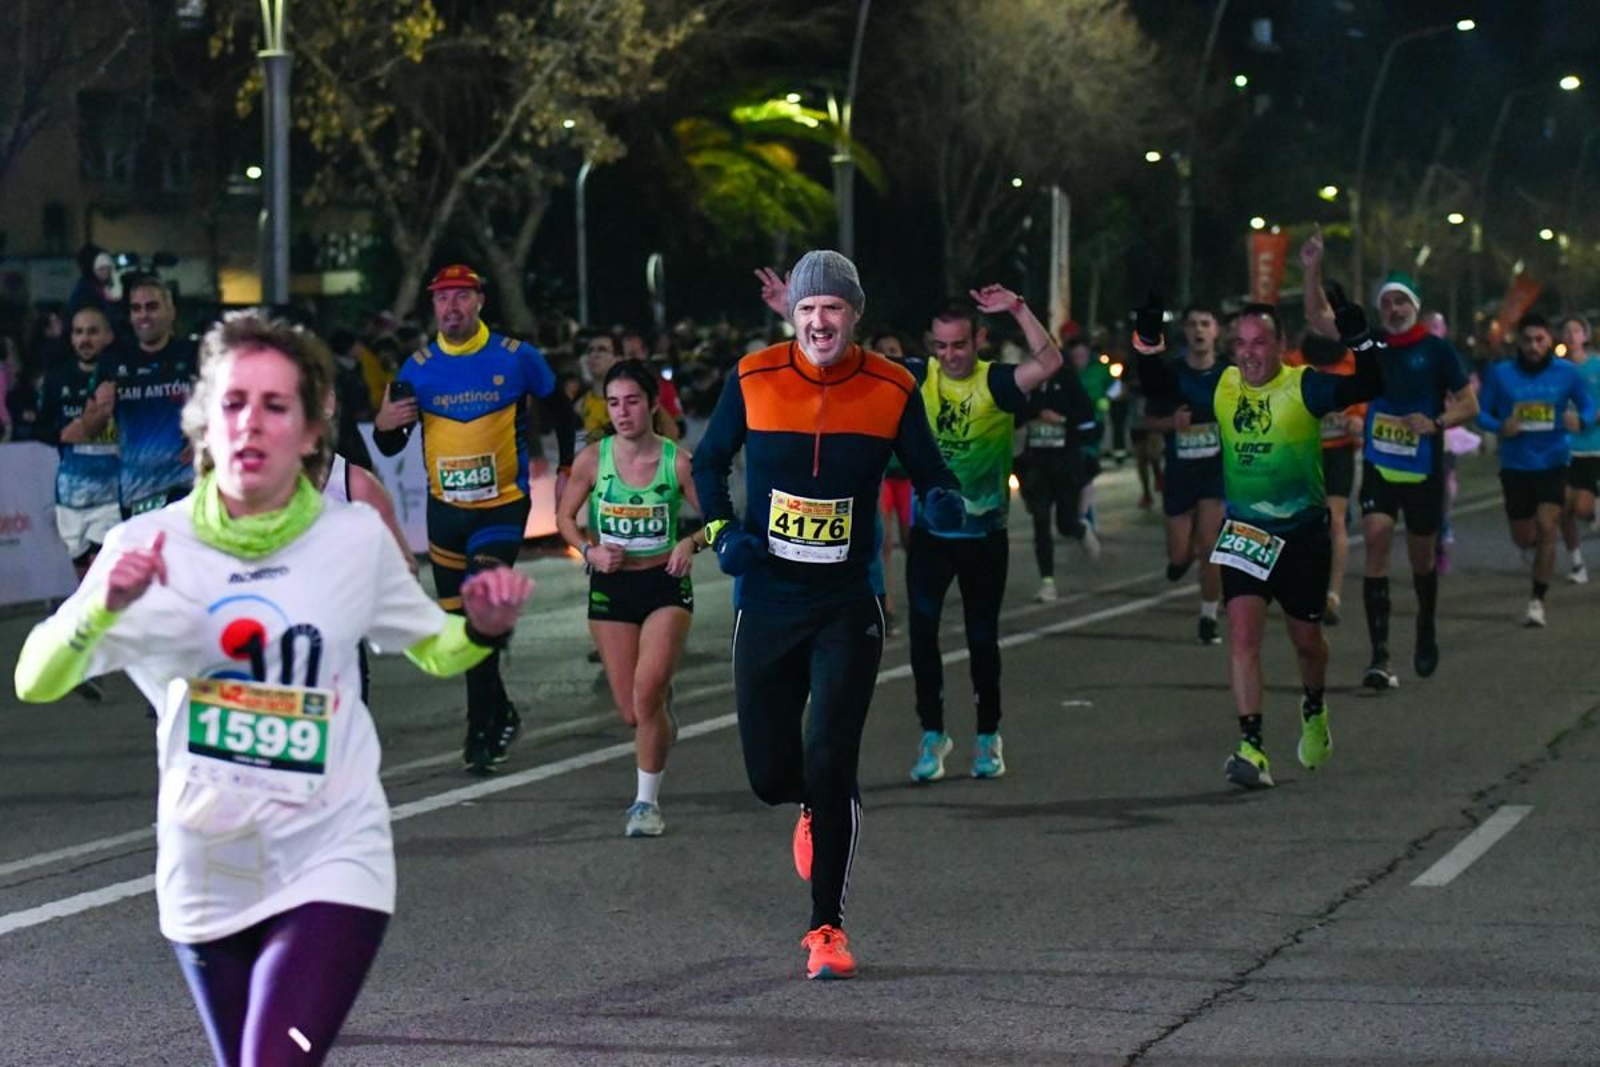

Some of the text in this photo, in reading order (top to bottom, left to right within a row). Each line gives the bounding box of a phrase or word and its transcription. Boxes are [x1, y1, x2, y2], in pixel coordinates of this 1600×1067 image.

[117, 380, 190, 400] SAN ANTÓN
[432, 389, 500, 408] agustinos
[1234, 441, 1274, 454] LINCE
[444, 467, 492, 487] 2348
[605, 516, 663, 535] 1010
[775, 512, 845, 539] 4176
[197, 705, 321, 761] 1599
